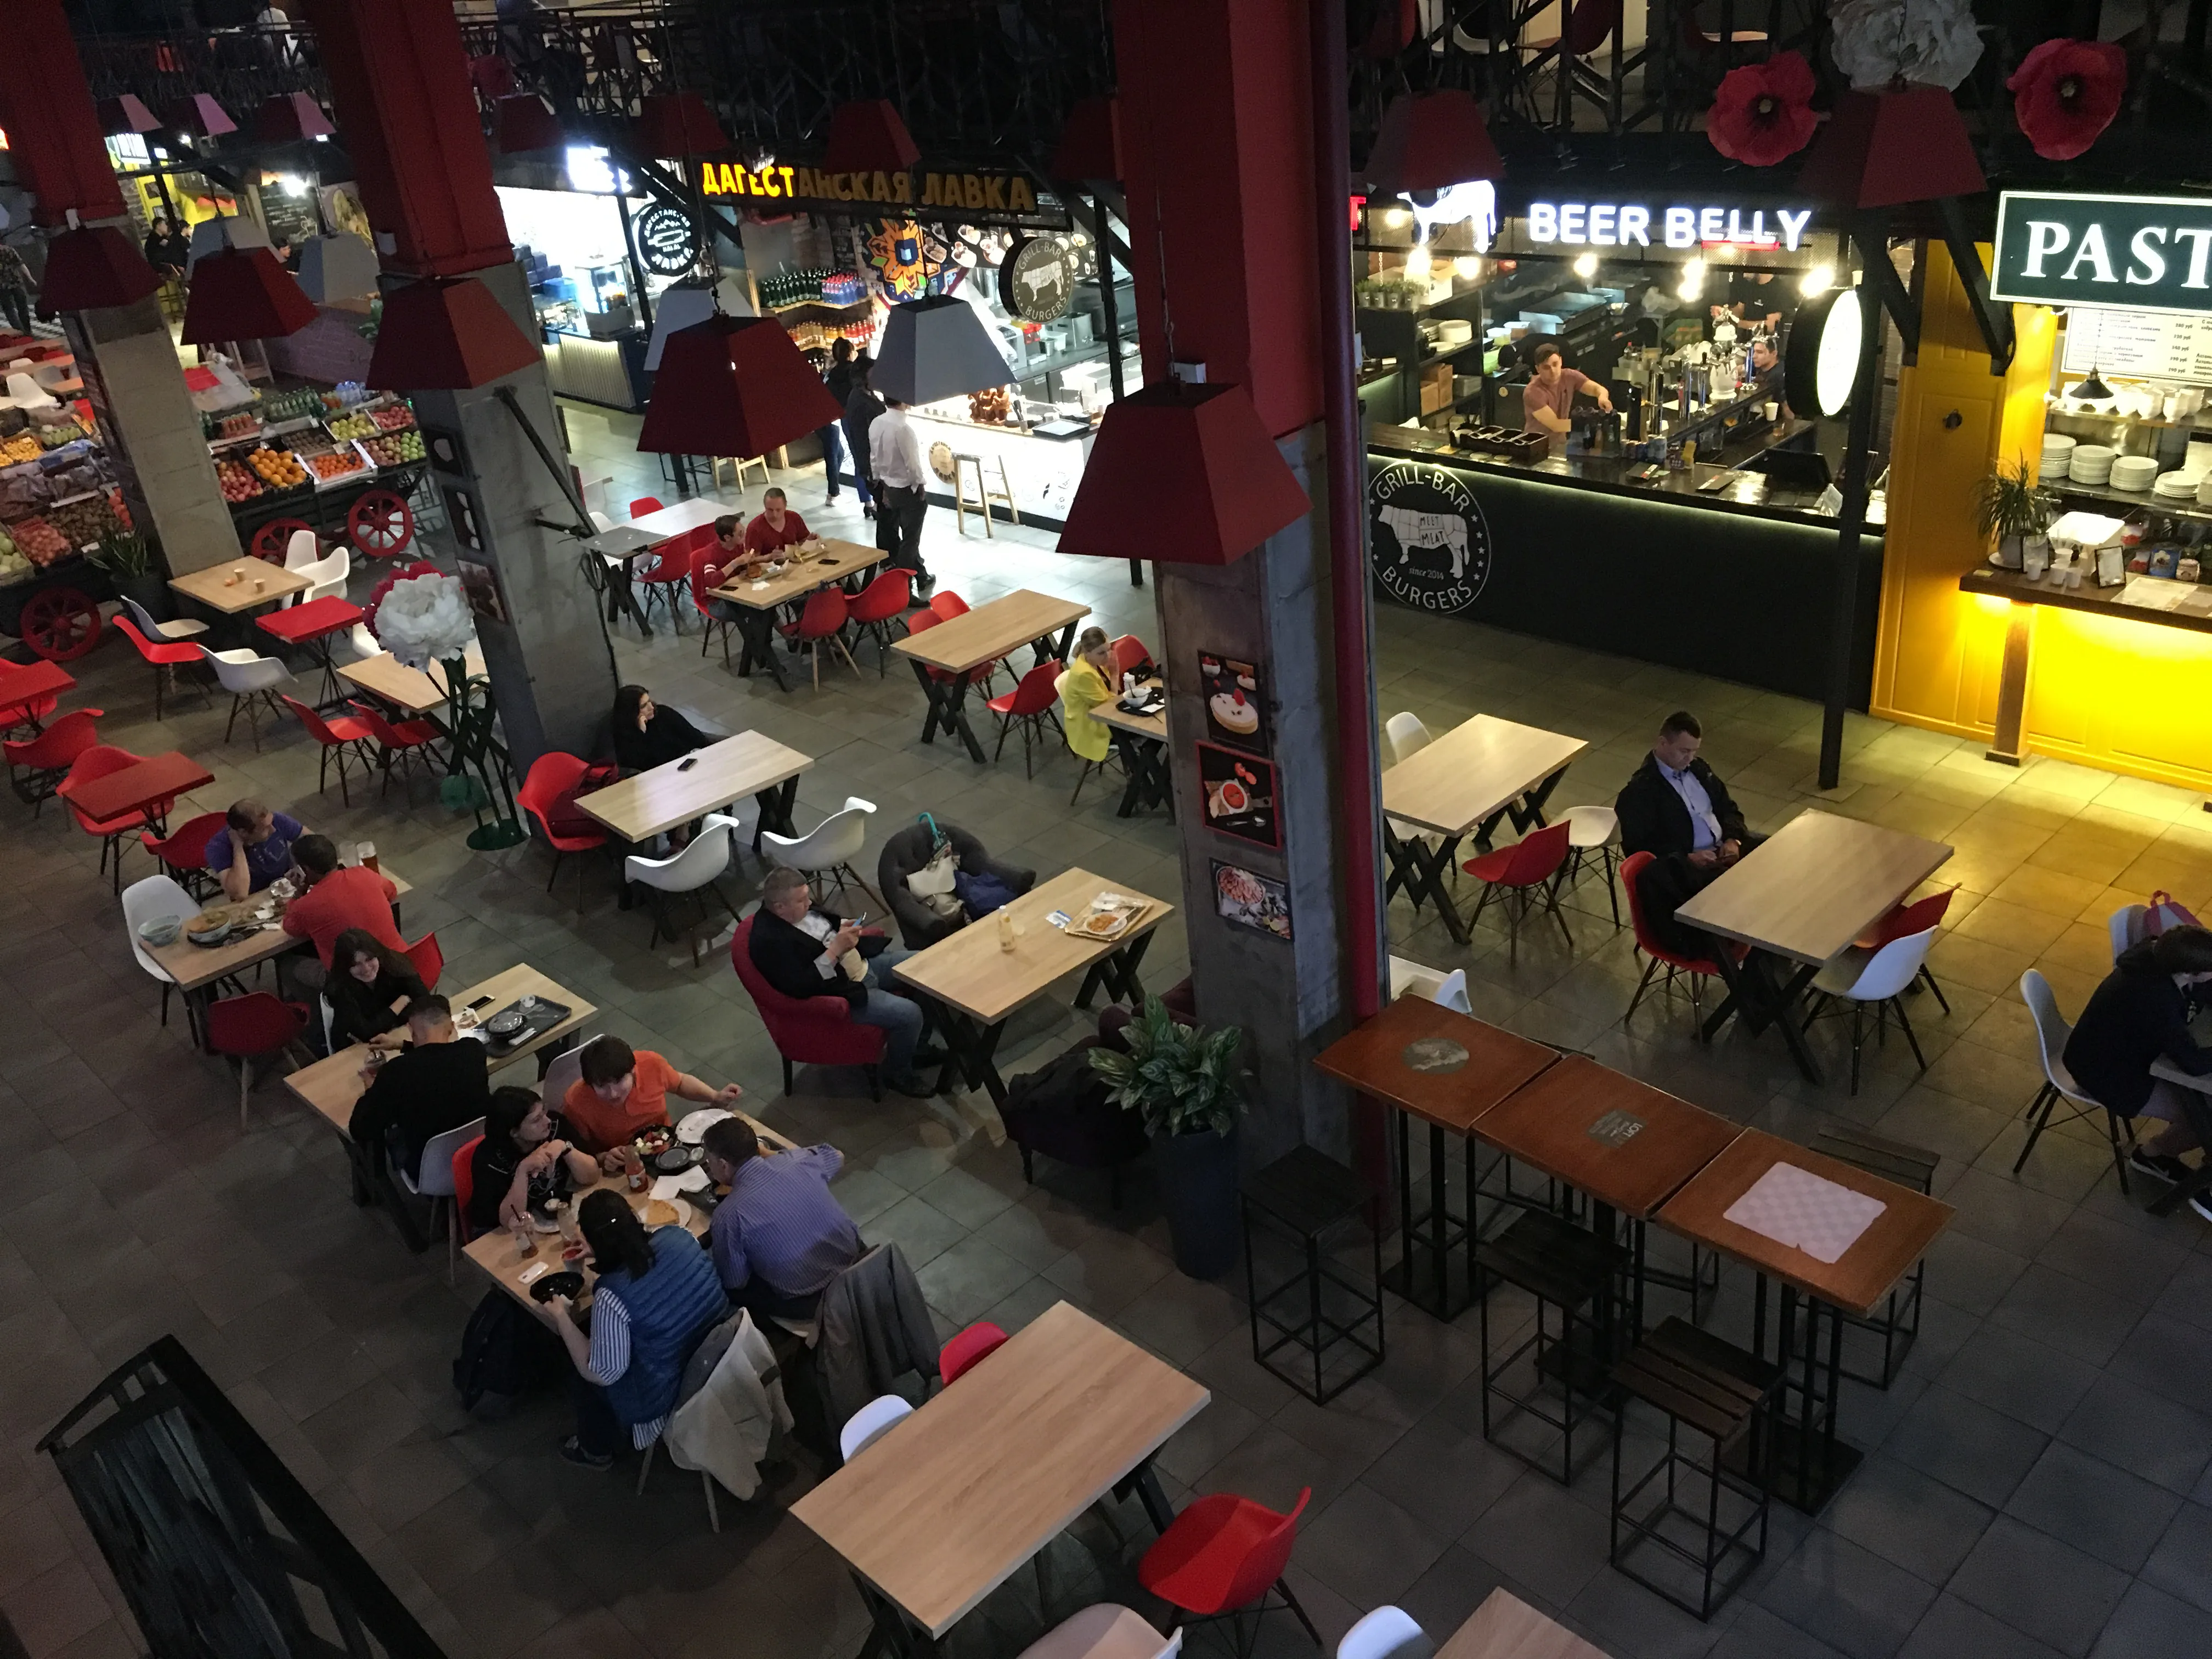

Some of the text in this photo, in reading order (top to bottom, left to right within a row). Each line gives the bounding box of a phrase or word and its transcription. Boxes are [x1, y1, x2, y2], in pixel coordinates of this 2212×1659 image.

[702, 162, 1035, 211] ДАГЕСТАНСКАЯ ЛАВКА
[644, 209, 691, 238] ДАГЕСТАНСАЯ
[1529, 203, 1812, 252] BEER BELLY
[1019, 242, 1062, 269] GRILL-BAR
[2020, 221, 2212, 289] PAST
[1025, 295, 1066, 321] BURGERS
[1376, 465, 1470, 512] GRILL-BAR
[1420, 516, 1440, 527] MEET
[1421, 530, 1444, 546] MEAT
[1383, 566, 1472, 610] BURGERS
[1409, 567, 1444, 580] since 2014
